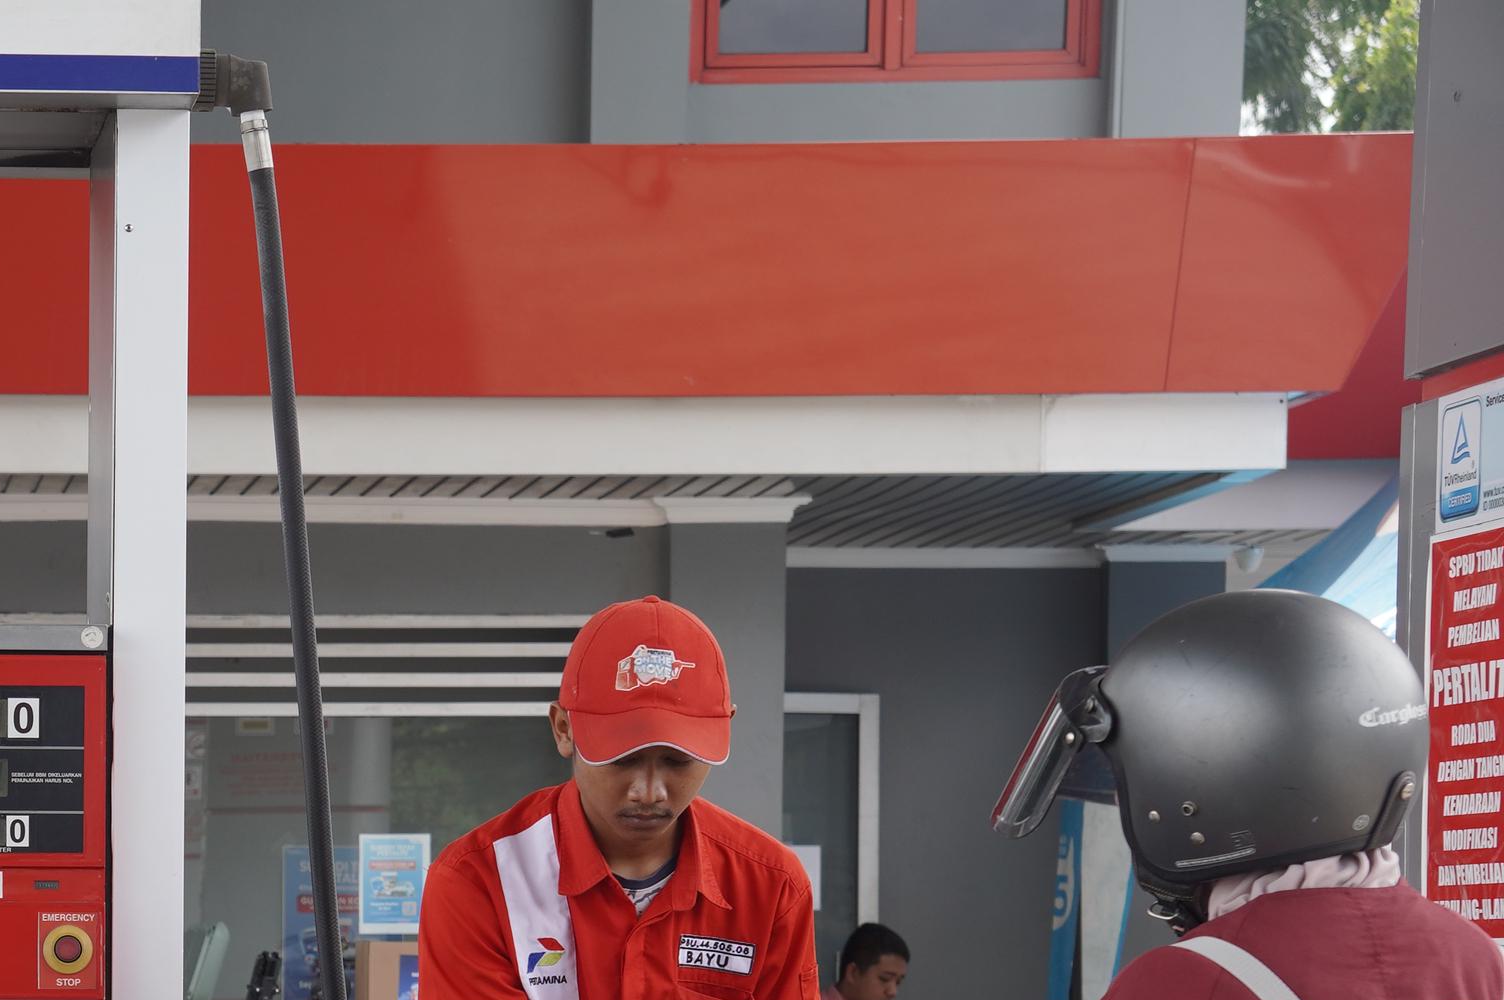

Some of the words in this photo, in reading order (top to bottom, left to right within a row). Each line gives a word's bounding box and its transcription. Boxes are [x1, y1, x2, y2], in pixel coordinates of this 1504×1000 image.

[1448, 553, 1475, 579] SPBU
[1476, 546, 1504, 573] TIDAK
[1453, 583, 1497, 613] MELAYANI
[1447, 618, 1501, 649] PEMBELIAN
[12, 702, 34, 734] 0
[1451, 723, 1477, 746] RODA
[1477, 720, 1496, 743] DUA
[1437, 759, 1475, 783] DENGAN
[1443, 791, 1501, 817] KENDARAAN
[9, 818, 26, 843] 0
[1442, 826, 1498, 851] MODIFIKASI
[1438, 865, 1456, 887] DAN
[41, 913, 95, 922] EMERGENCY
[1433, 898, 1504, 922] ULANG-ULA
[686, 951, 730, 969] BAYU
[56, 978, 81, 987] STOP
